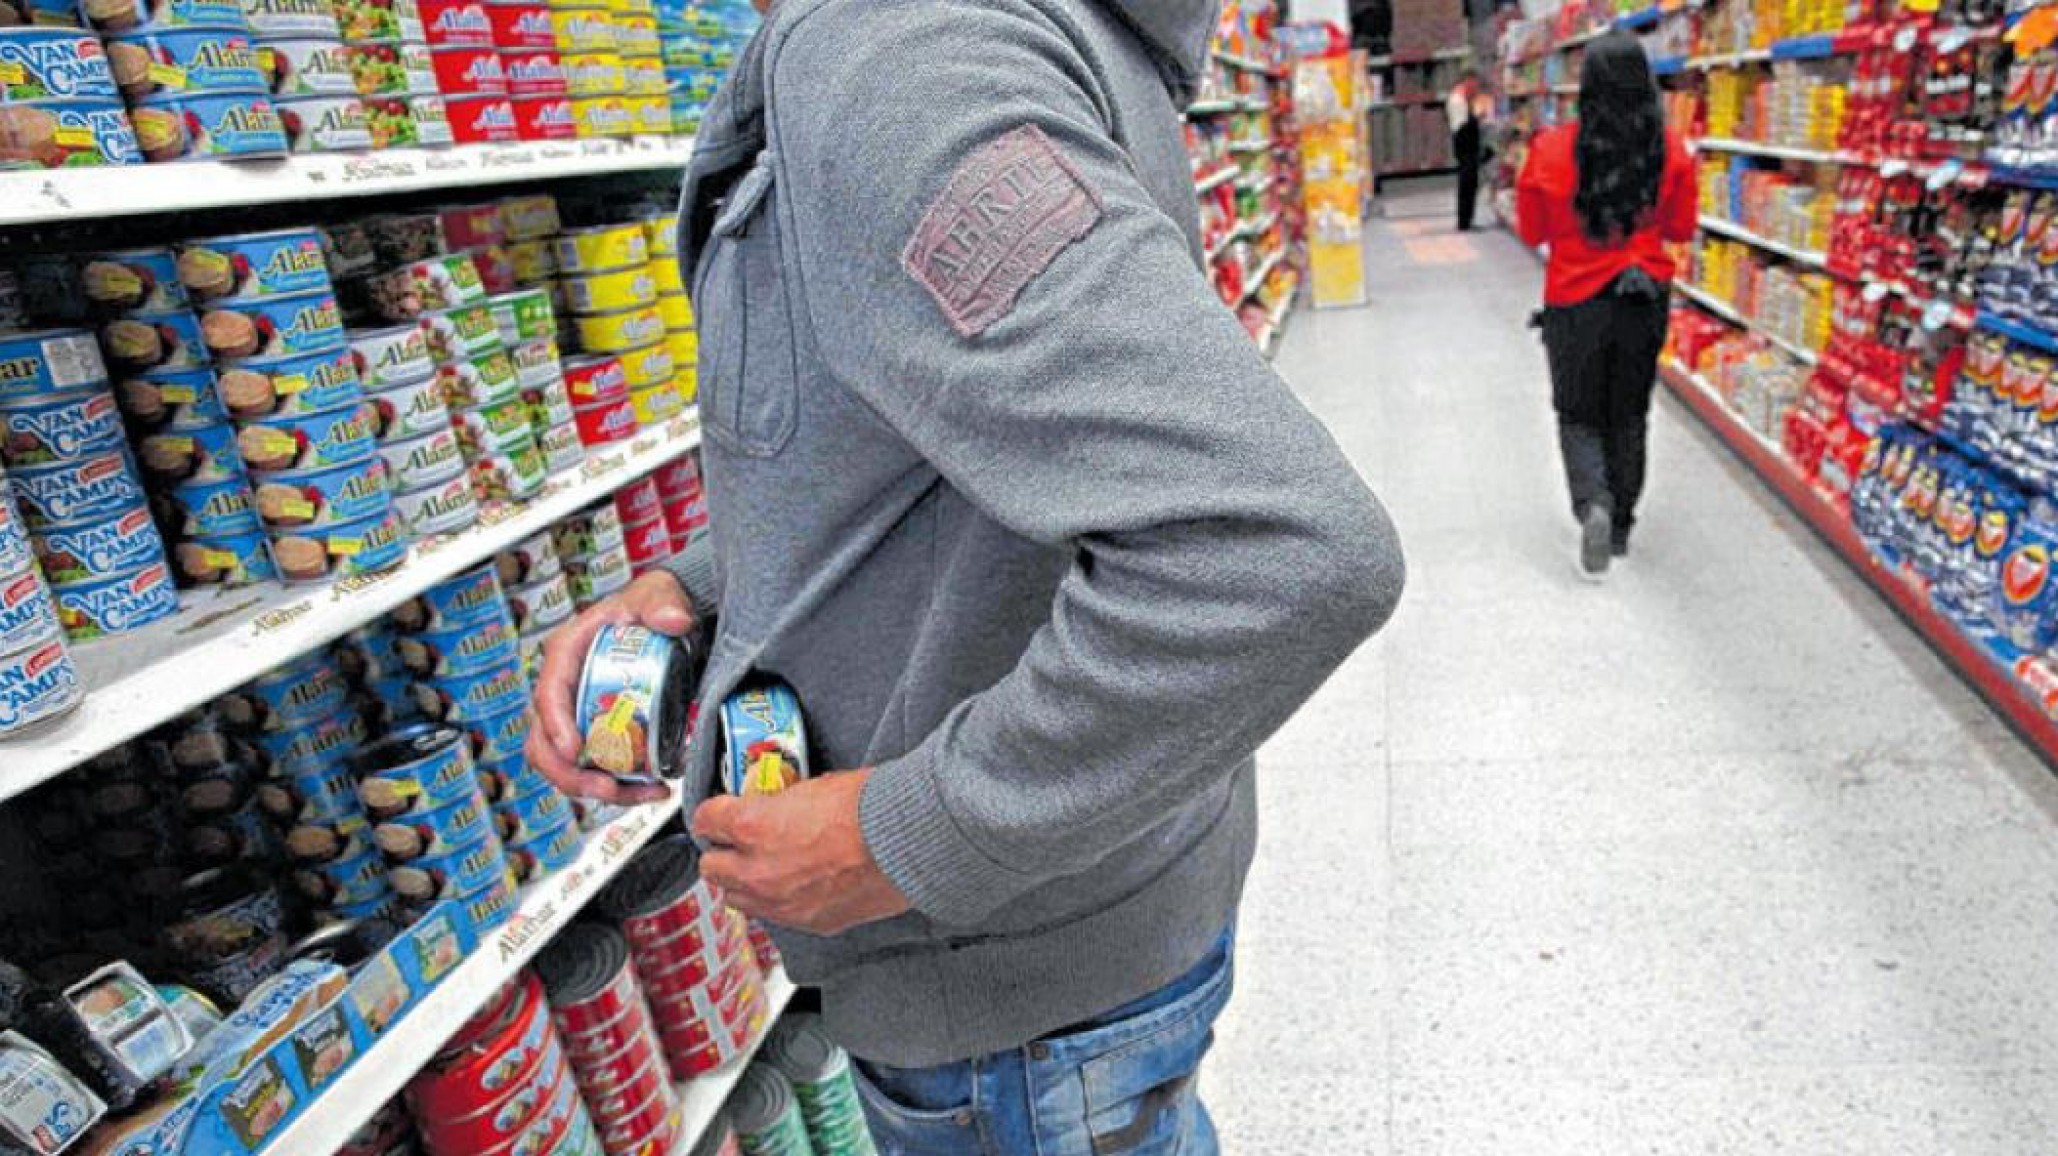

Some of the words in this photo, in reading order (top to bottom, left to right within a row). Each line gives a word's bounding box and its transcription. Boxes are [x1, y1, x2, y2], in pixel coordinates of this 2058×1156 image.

[0, 40, 78, 80] VAN
[9, 402, 86, 436] VAN
[8, 468, 79, 502] VAN
[48, 521, 118, 558] VAN
[60, 578, 132, 620] VAN
